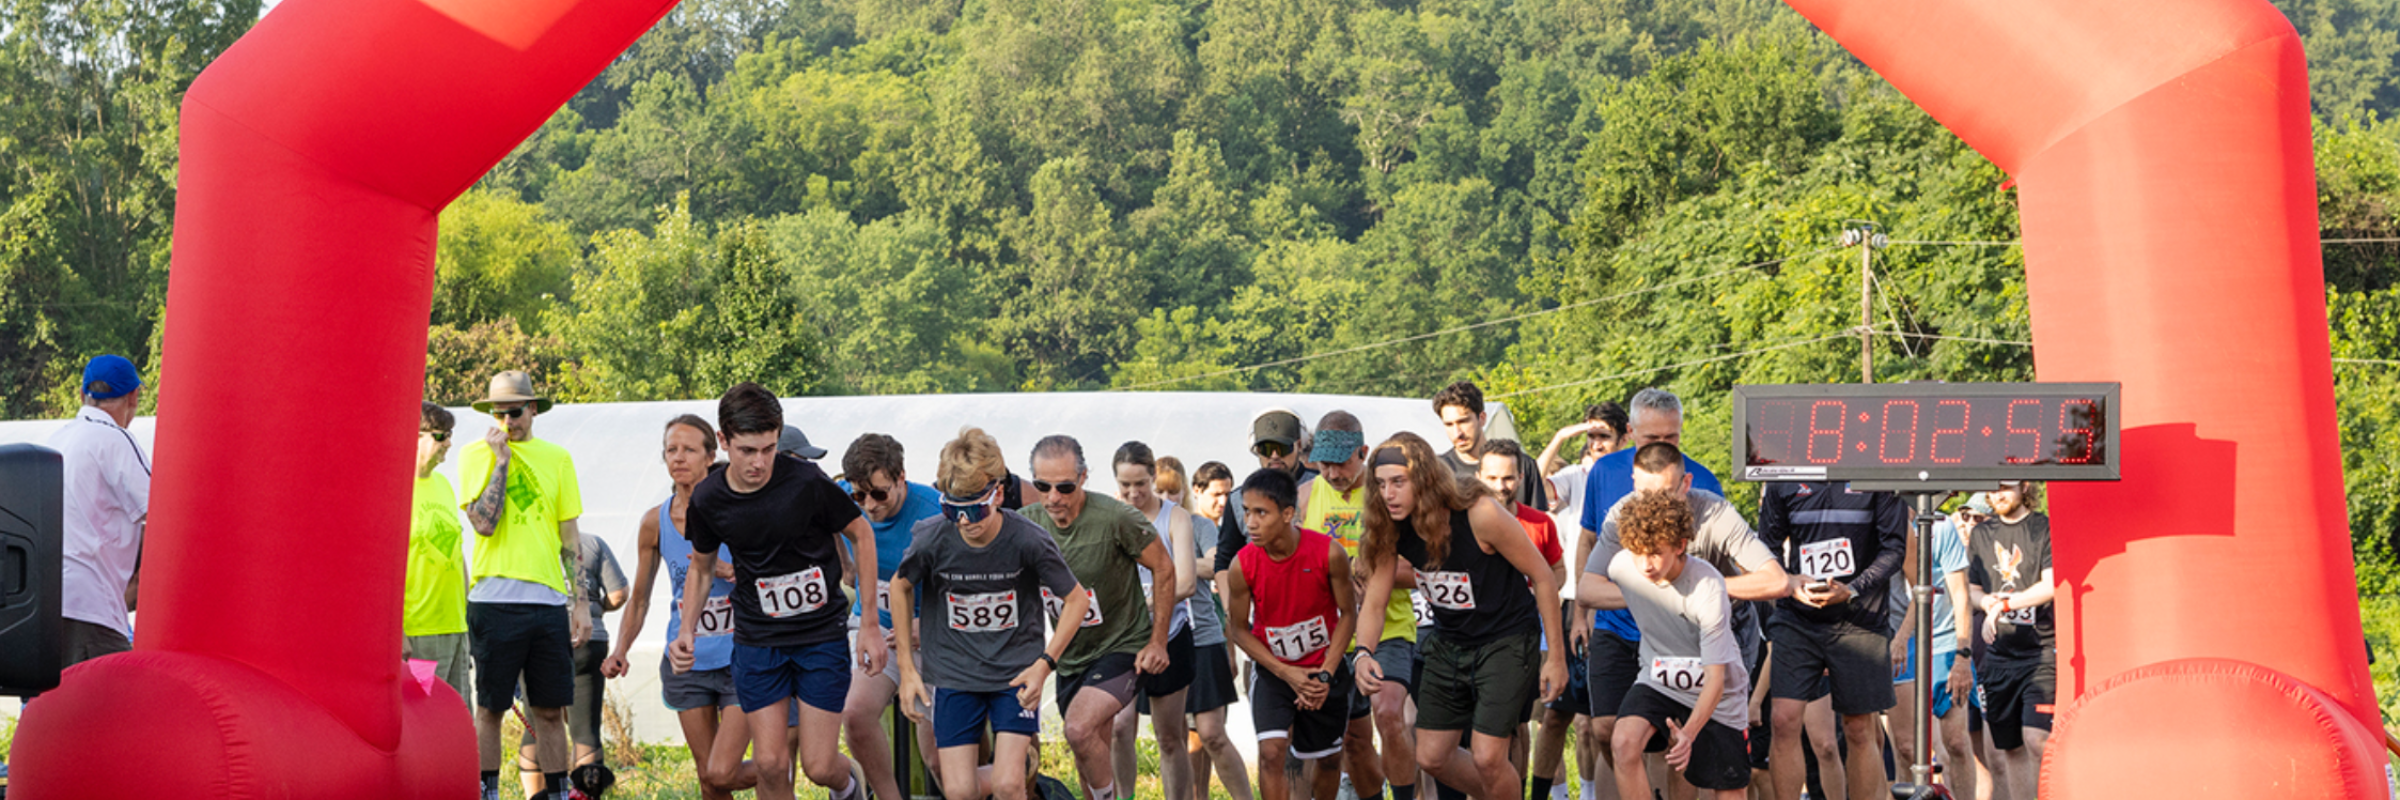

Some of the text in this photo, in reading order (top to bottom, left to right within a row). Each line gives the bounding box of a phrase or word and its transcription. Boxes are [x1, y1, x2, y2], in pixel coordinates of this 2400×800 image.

[1804, 549, 1850, 575] 120
[764, 581, 823, 612] 108
[1420, 582, 1470, 604] 126
[696, 606, 732, 632] 07
[952, 603, 1013, 628] 589
[1274, 627, 1326, 657] 115
